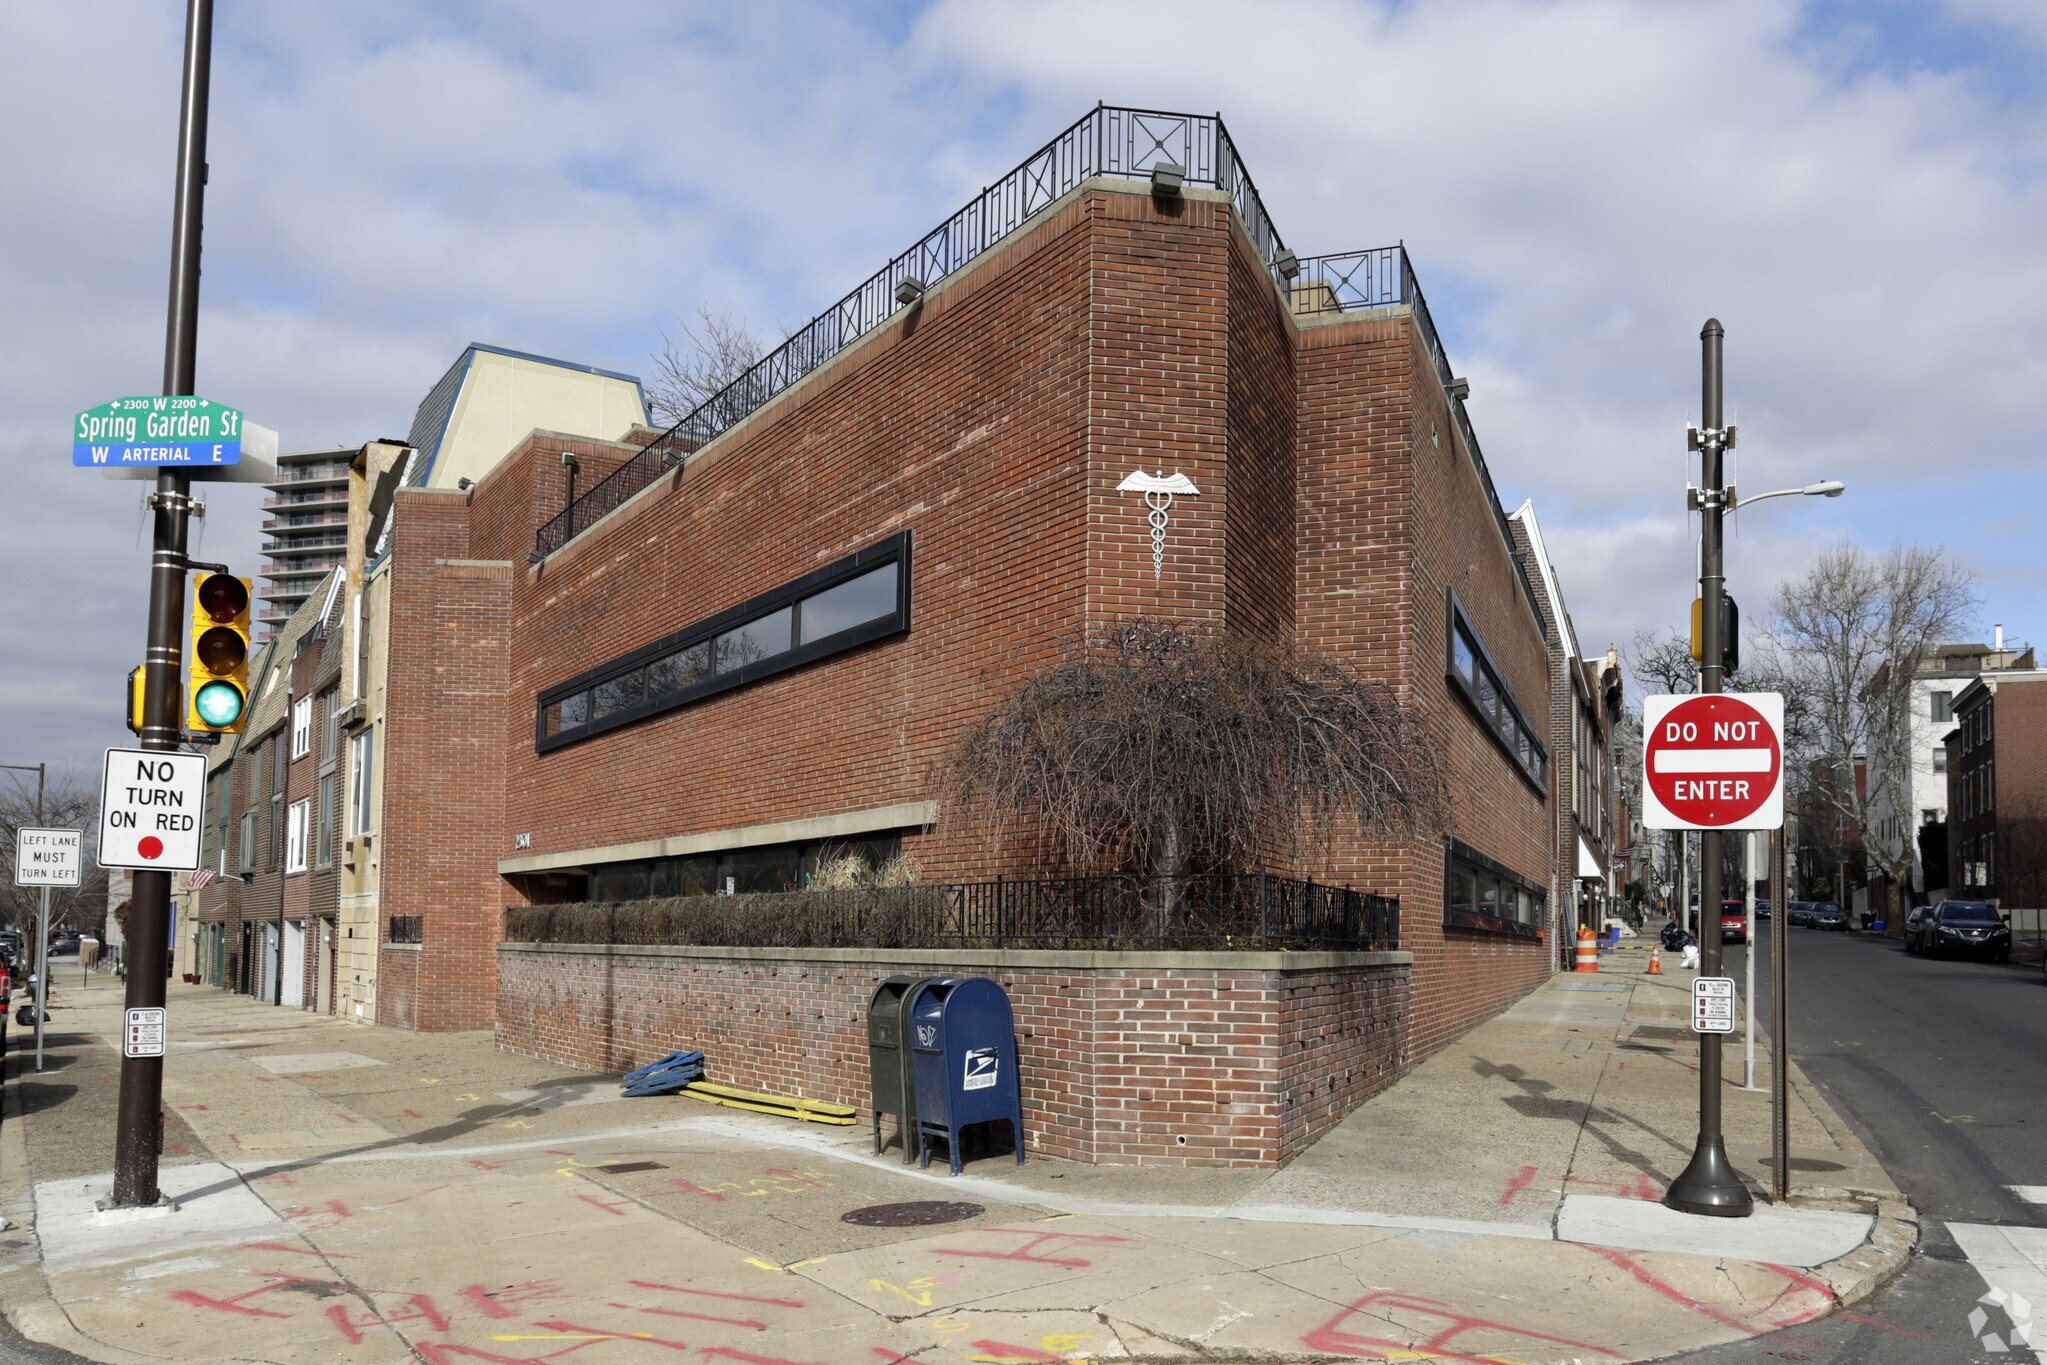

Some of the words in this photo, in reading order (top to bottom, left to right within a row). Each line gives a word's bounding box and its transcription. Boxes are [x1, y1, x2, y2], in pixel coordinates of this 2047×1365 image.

[123, 400, 149, 410] 2300
[153, 397, 168, 411] W
[171, 399, 197, 409] 2200
[79, 411, 137, 443] Spring
[147, 410, 210, 438] Garden
[219, 410, 239, 436] St
[91, 446, 110, 464] W
[122, 447, 191, 461] ARTERIAL
[212, 444, 223, 462] E
[1666, 722, 1698, 742] DO
[1714, 721, 1760, 742] NOT
[136, 760, 175, 783] NO
[126, 787, 183, 807] TURN
[1674, 780, 1750, 801] ENTER
[110, 810, 137, 828] ON
[156, 813, 194, 831] RED
[23, 836, 47, 846] LEFT
[52, 836, 77, 846] LANE
[33, 851, 66, 863] MUST
[22, 869, 47, 878] TURN
[52, 869, 76, 879] LEFT
